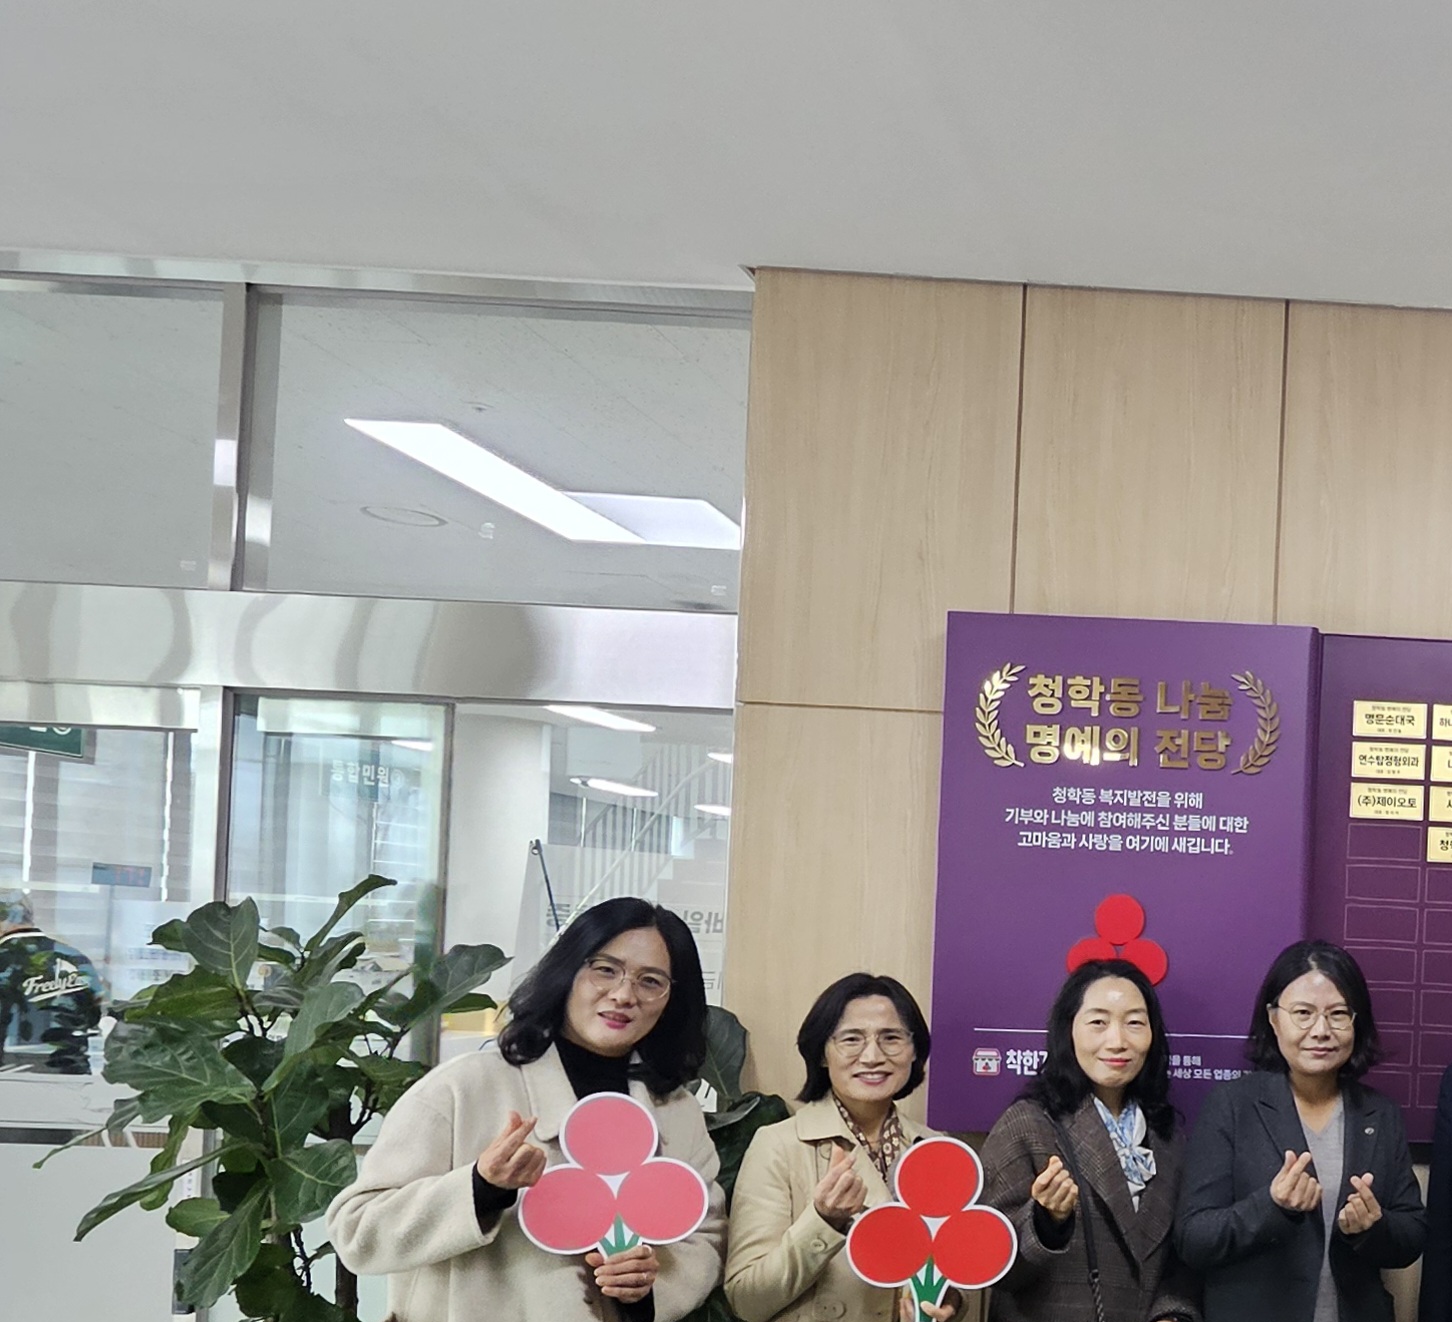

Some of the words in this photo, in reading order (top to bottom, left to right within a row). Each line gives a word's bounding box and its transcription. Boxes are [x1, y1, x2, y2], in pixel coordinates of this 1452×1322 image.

[1028, 674, 1144, 717] 청학동
[1156, 681, 1232, 721] 나눔
[1364, 713, 1415, 727] 명문순대국
[1026, 723, 1138, 767] 명예의
[1155, 729, 1231, 771] 전당
[1358, 755, 1419, 768] 연수탑정형외과
[1052, 786, 1096, 804] 청학동
[1099, 788, 1171, 808] 복지발전을
[1174, 792, 1203, 809] 위해
[1358, 796, 1417, 809] (주)제이오토
[1005, 808, 1048, 825] 기부와
[1051, 810, 1094, 827] 나눔에
[1098, 812, 1169, 831] 참여해주신
[1173, 814, 1215, 832] 분들에
[1219, 817, 1248, 834] 대한
[1018, 832, 1076, 849] 고마움과
[1079, 834, 1121, 852] 사랑을
[1126, 836, 1168, 853] 여기에
[1172, 838, 1234, 855] 새깁니다.
[1173, 1068, 1192, 1078] 세상
[1193, 1069, 1212, 1079] 모든
